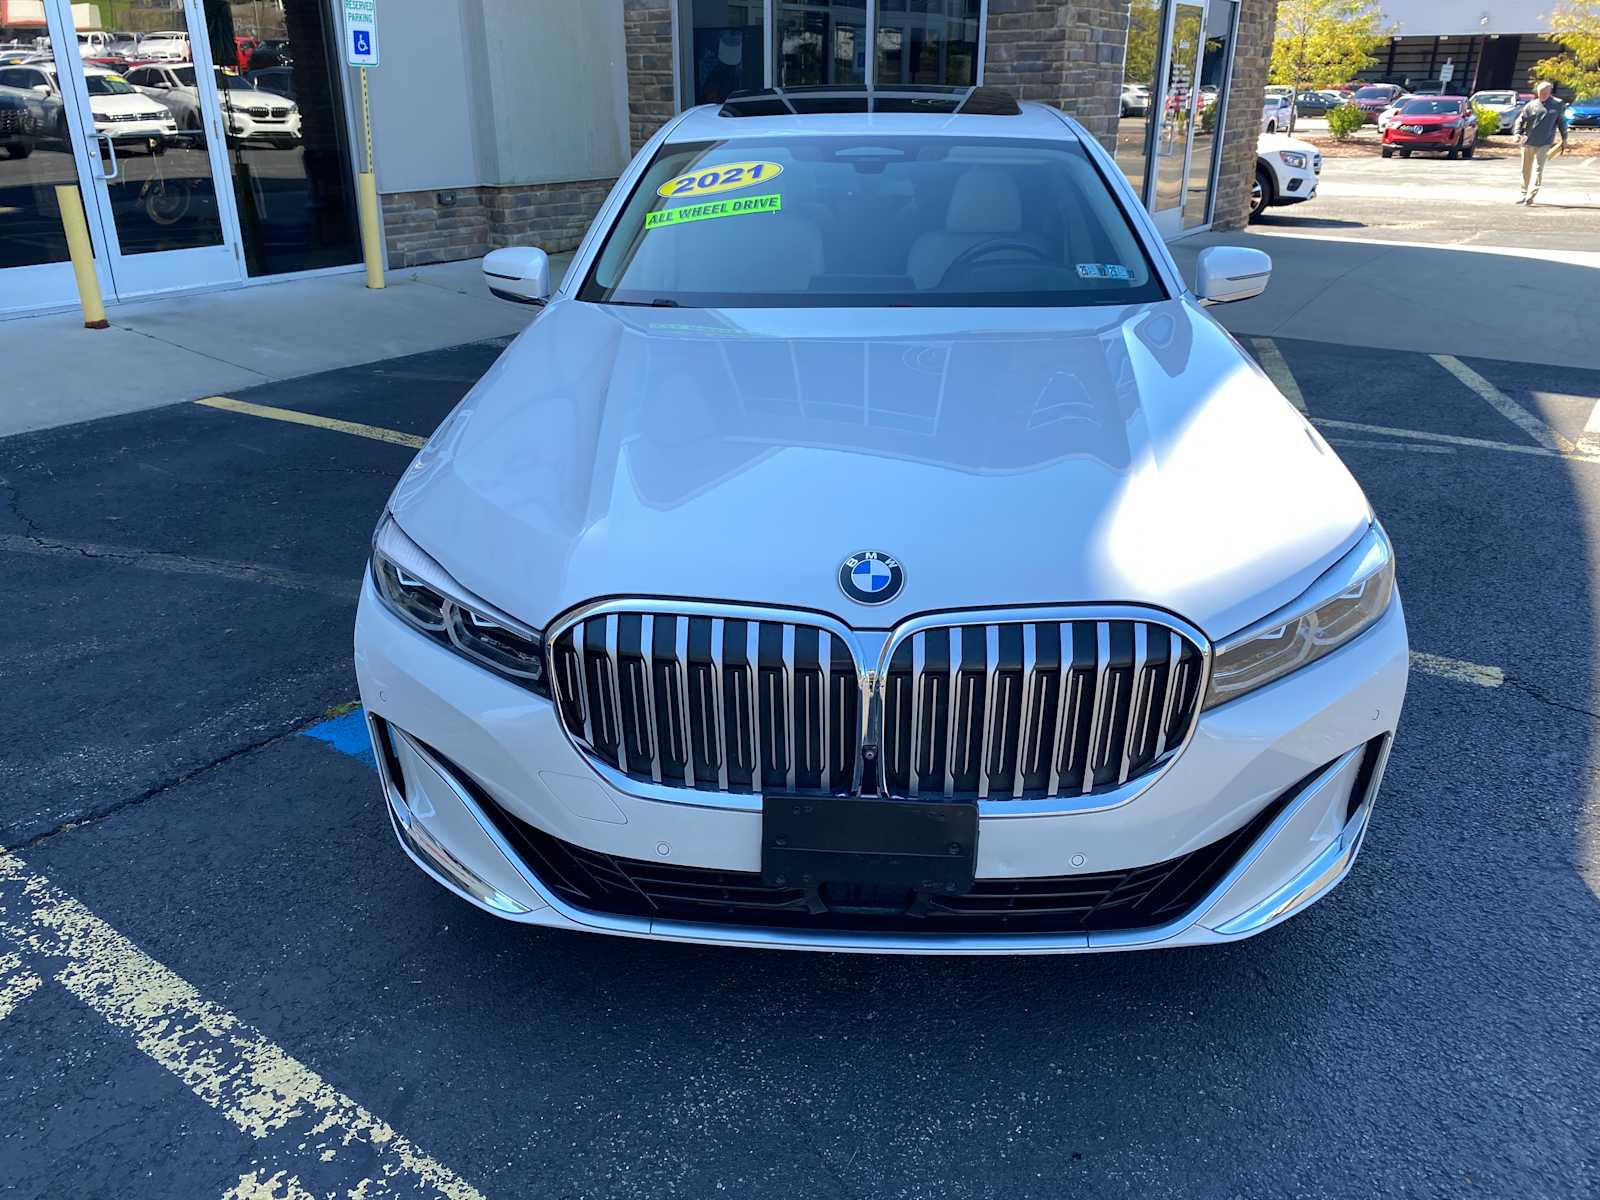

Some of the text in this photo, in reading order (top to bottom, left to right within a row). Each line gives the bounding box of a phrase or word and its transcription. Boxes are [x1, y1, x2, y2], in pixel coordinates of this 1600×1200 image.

[344, 0, 374, 10] RESERVED
[347, 12, 374, 24] PARKING
[671, 164, 765, 195] 2021
[648, 197, 779, 226] ALL WHEEL DRIVE
[846, 552, 898, 568] BMW
